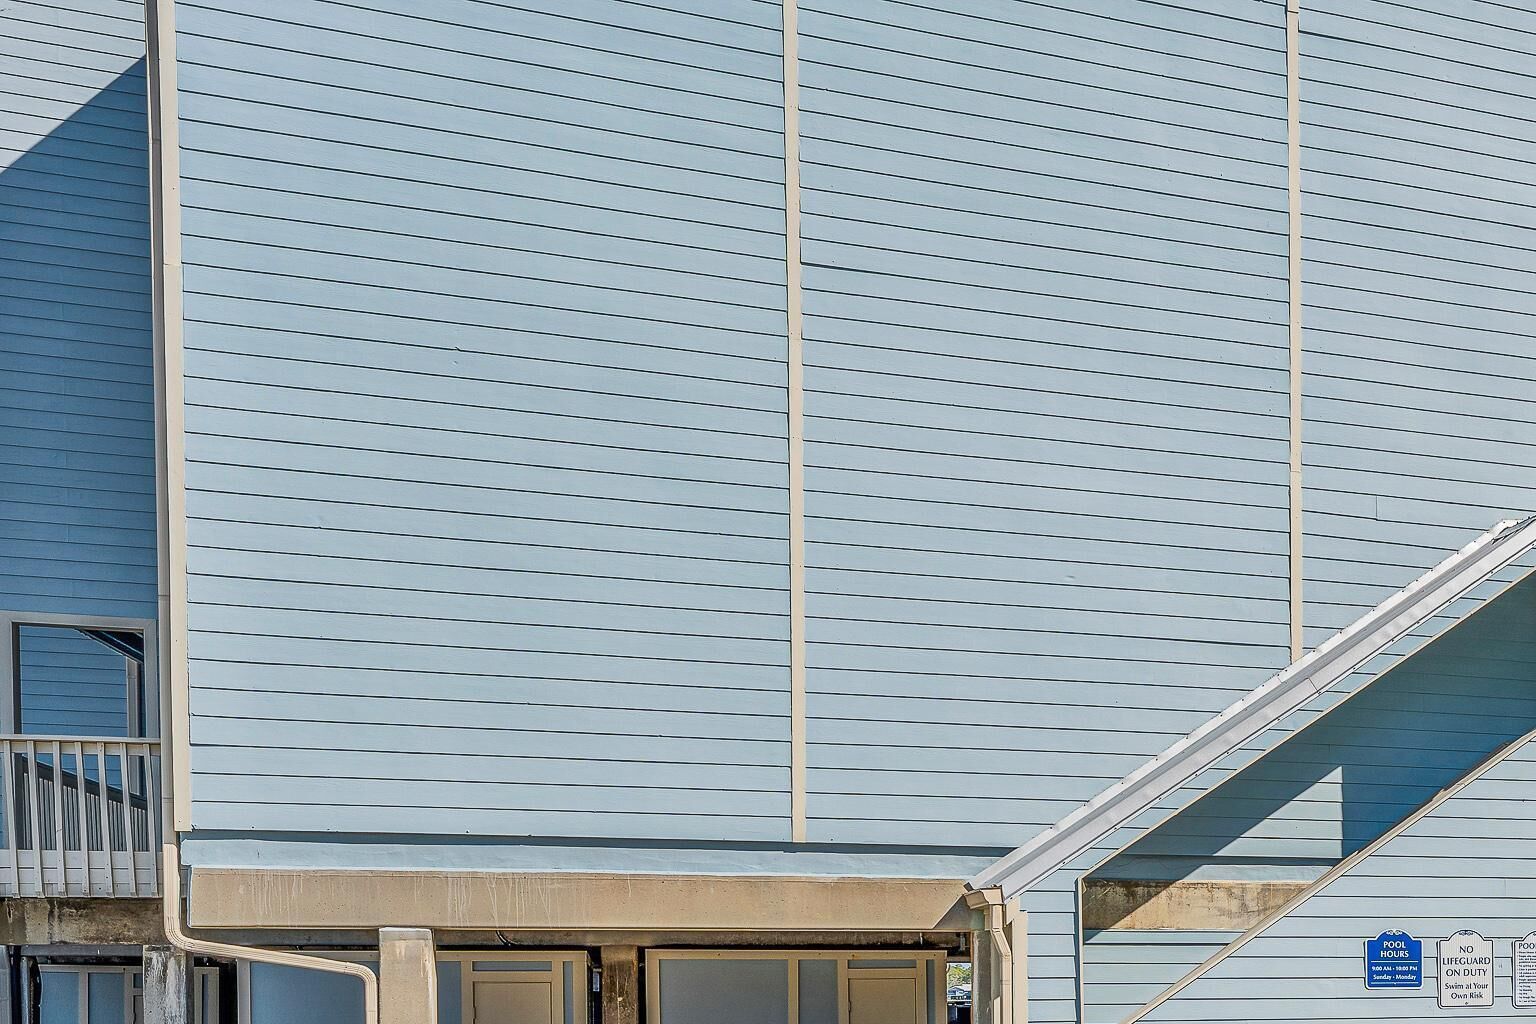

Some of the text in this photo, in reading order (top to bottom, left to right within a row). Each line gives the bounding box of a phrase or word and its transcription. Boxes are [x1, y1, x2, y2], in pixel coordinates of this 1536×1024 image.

[1383, 941, 1406, 949] POOL
[1459, 945, 1474, 954] NO
[1380, 950, 1409, 958] HOURS
[1442, 957, 1491, 965] LIFEGUARD
[1446, 968, 1487, 977] ON DUTY
[1444, 982, 1464, 990] Swim
[1473, 982, 1489, 990] Your
[1450, 992, 1484, 1000] Own Risk
